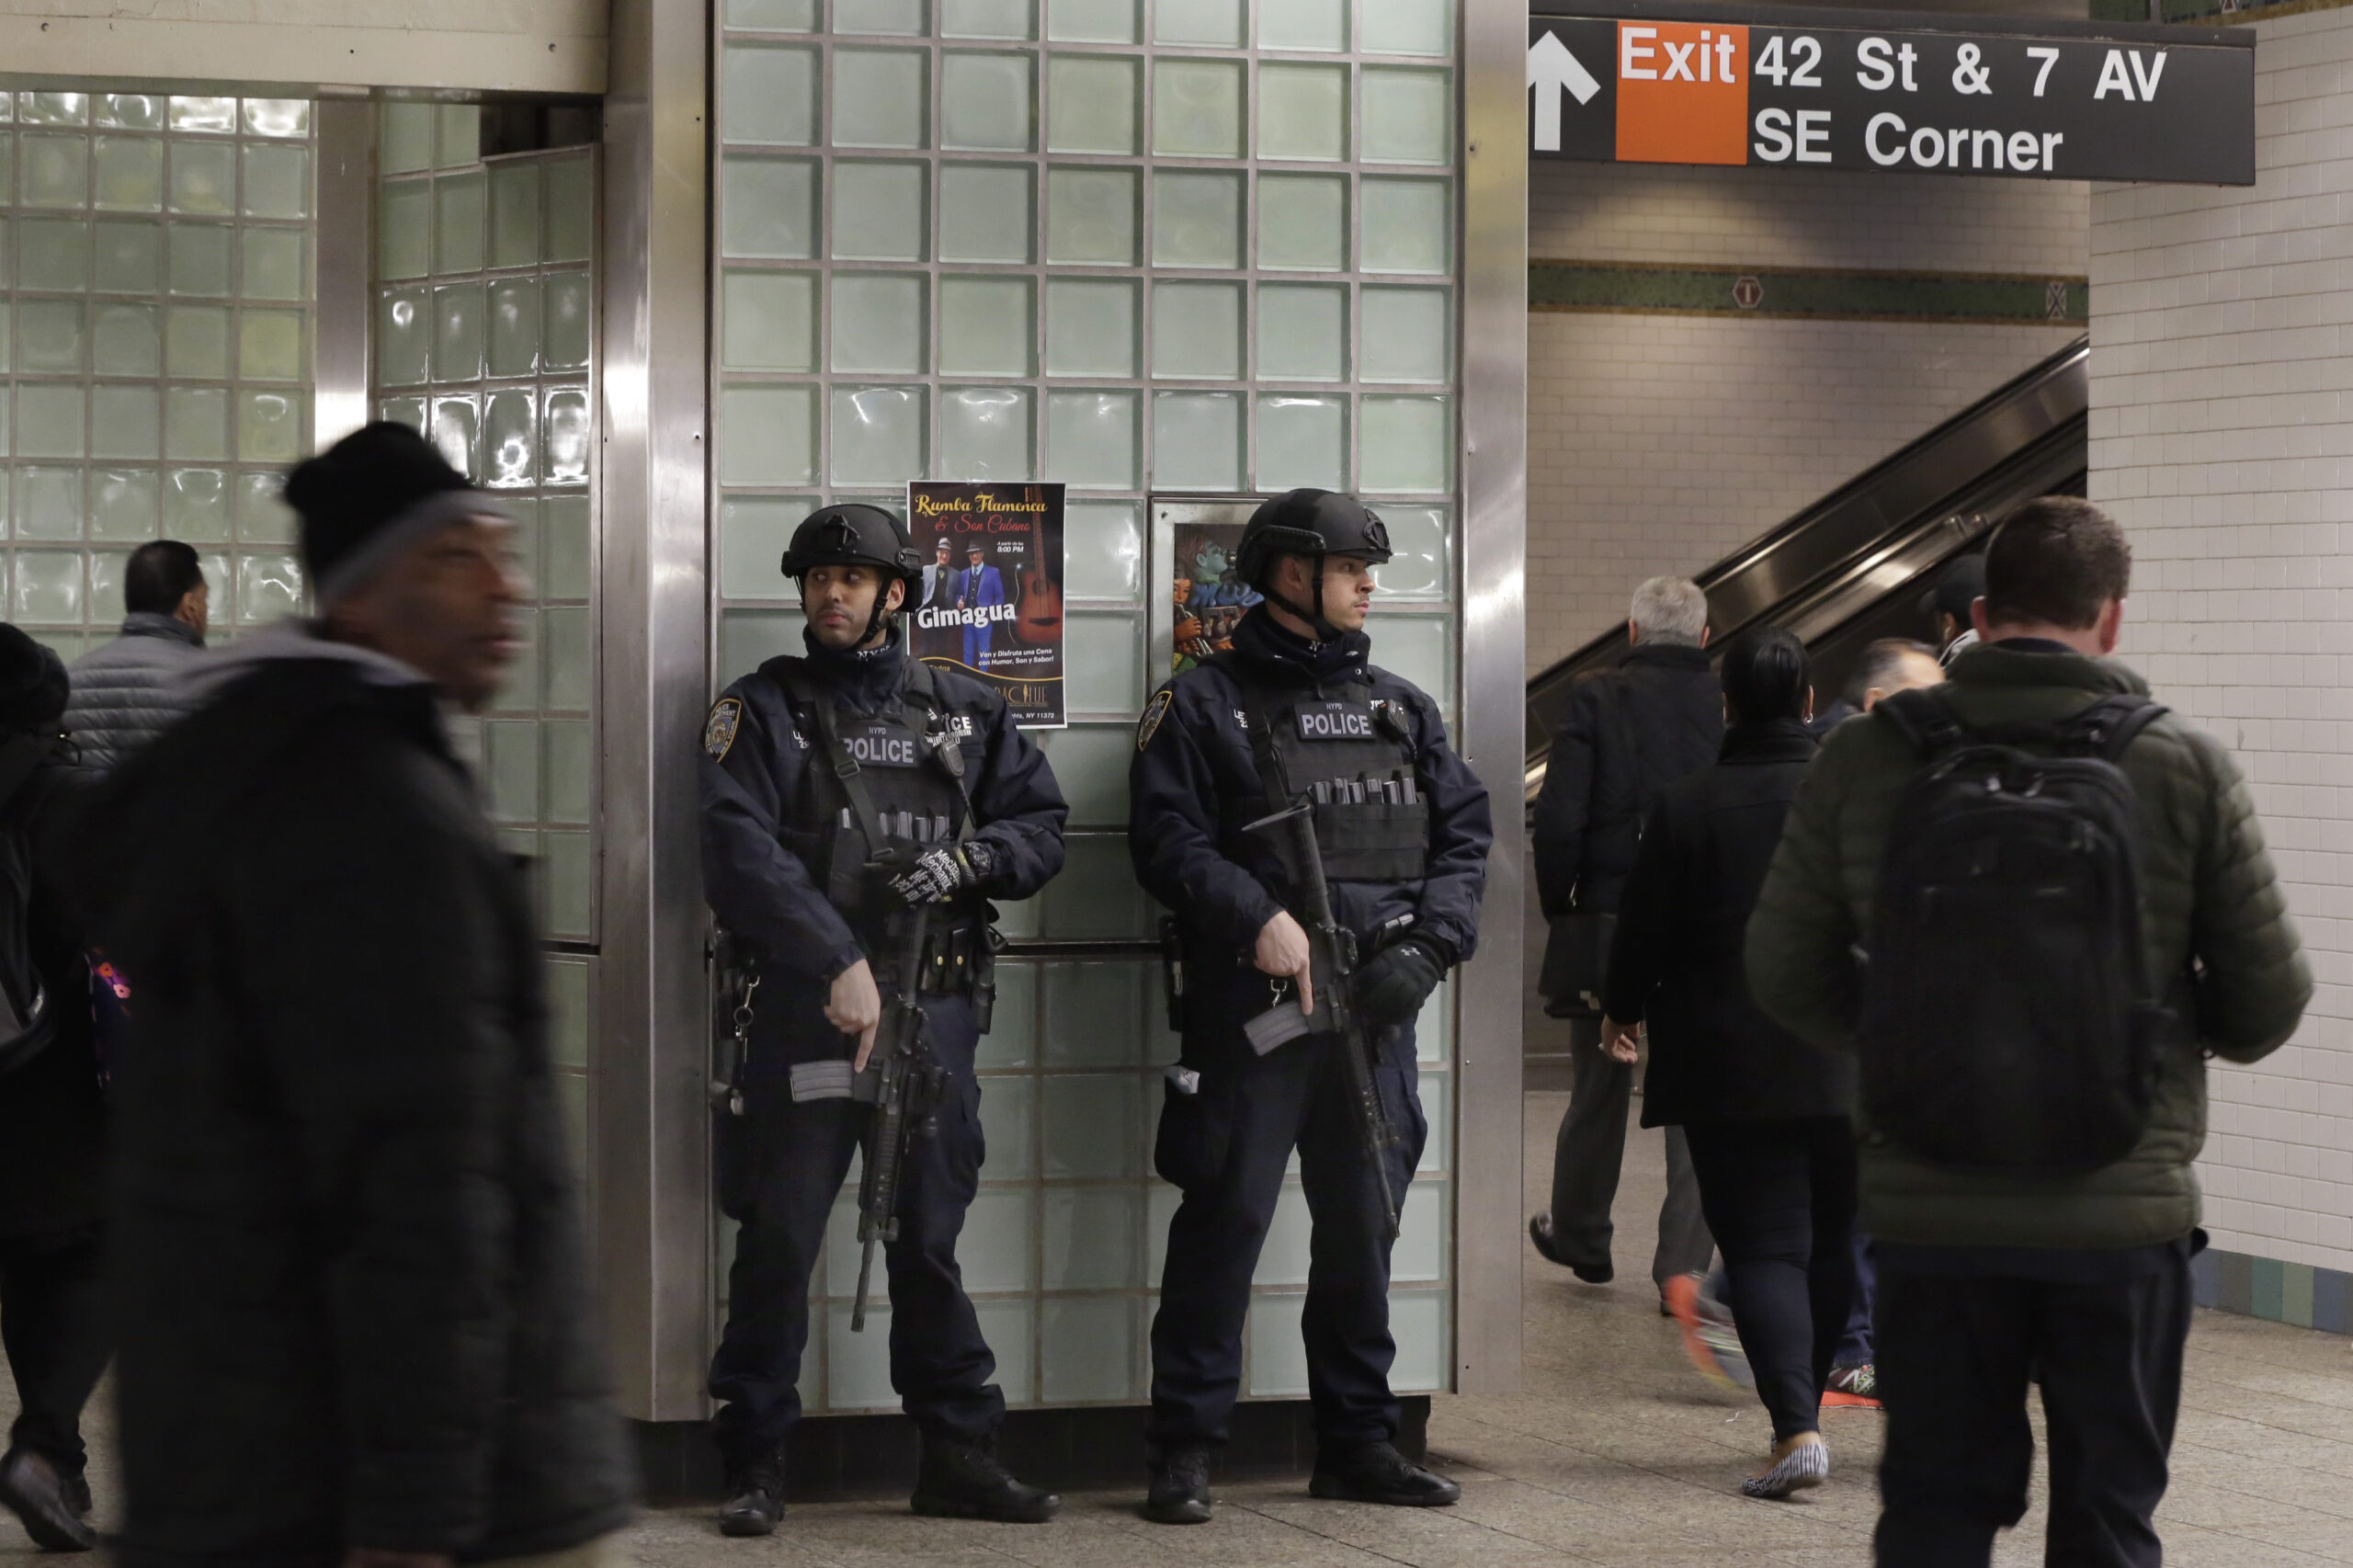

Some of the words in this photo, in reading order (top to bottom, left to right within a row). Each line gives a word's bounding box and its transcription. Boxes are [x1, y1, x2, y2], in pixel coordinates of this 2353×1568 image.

[1620, 26, 1736, 84] Exit
[1755, 35, 1823, 87] 42
[1857, 37, 1918, 92] St
[1951, 42, 1994, 96] &
[2027, 47, 2060, 97] 7
[2093, 49, 2167, 102] AV
[1754, 108, 1833, 163] SE
[1865, 112, 2063, 172] Corner
[915, 494, 972, 517] Rumba
[974, 492, 1048, 514] Flamenca
[954, 514, 983, 533] Son
[987, 514, 1031, 534] Cubano
[917, 603, 1017, 629] Gimagua
[1325, 702, 1343, 710] NYPD
[869, 726, 886, 734] NYPD
[1302, 713, 1372, 735] POLICE
